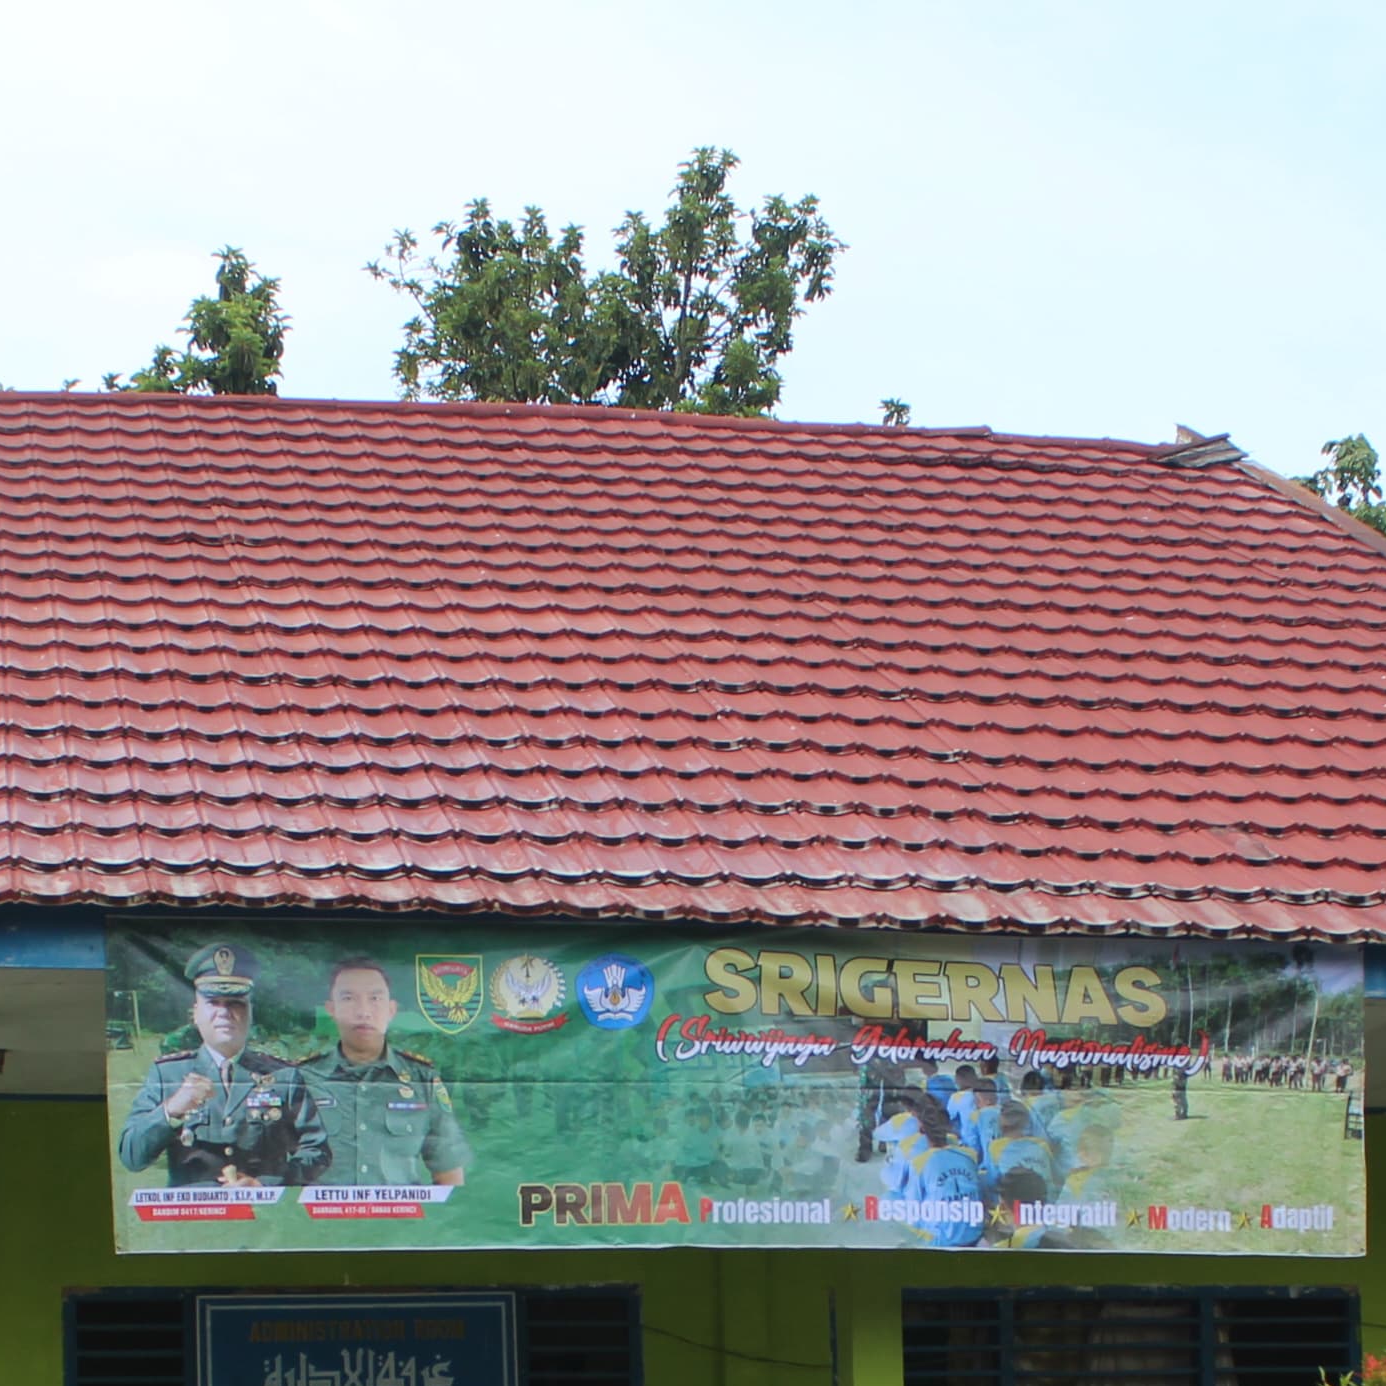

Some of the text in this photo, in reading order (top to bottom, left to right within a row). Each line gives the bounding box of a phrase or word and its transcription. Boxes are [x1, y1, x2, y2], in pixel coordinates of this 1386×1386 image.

[703, 947, 1169, 1030] SRIGERNAS
[135, 1192, 160, 1203] LETKOL
[163, 1192, 175, 1202] INF
[177, 1192, 191, 1202] EKO
[315, 1188, 431, 1201] LETTU INF YELPANIDI
[519, 1181, 1334, 1233] PRIMA Profesional Responsip Integratif Modern Adaptif
